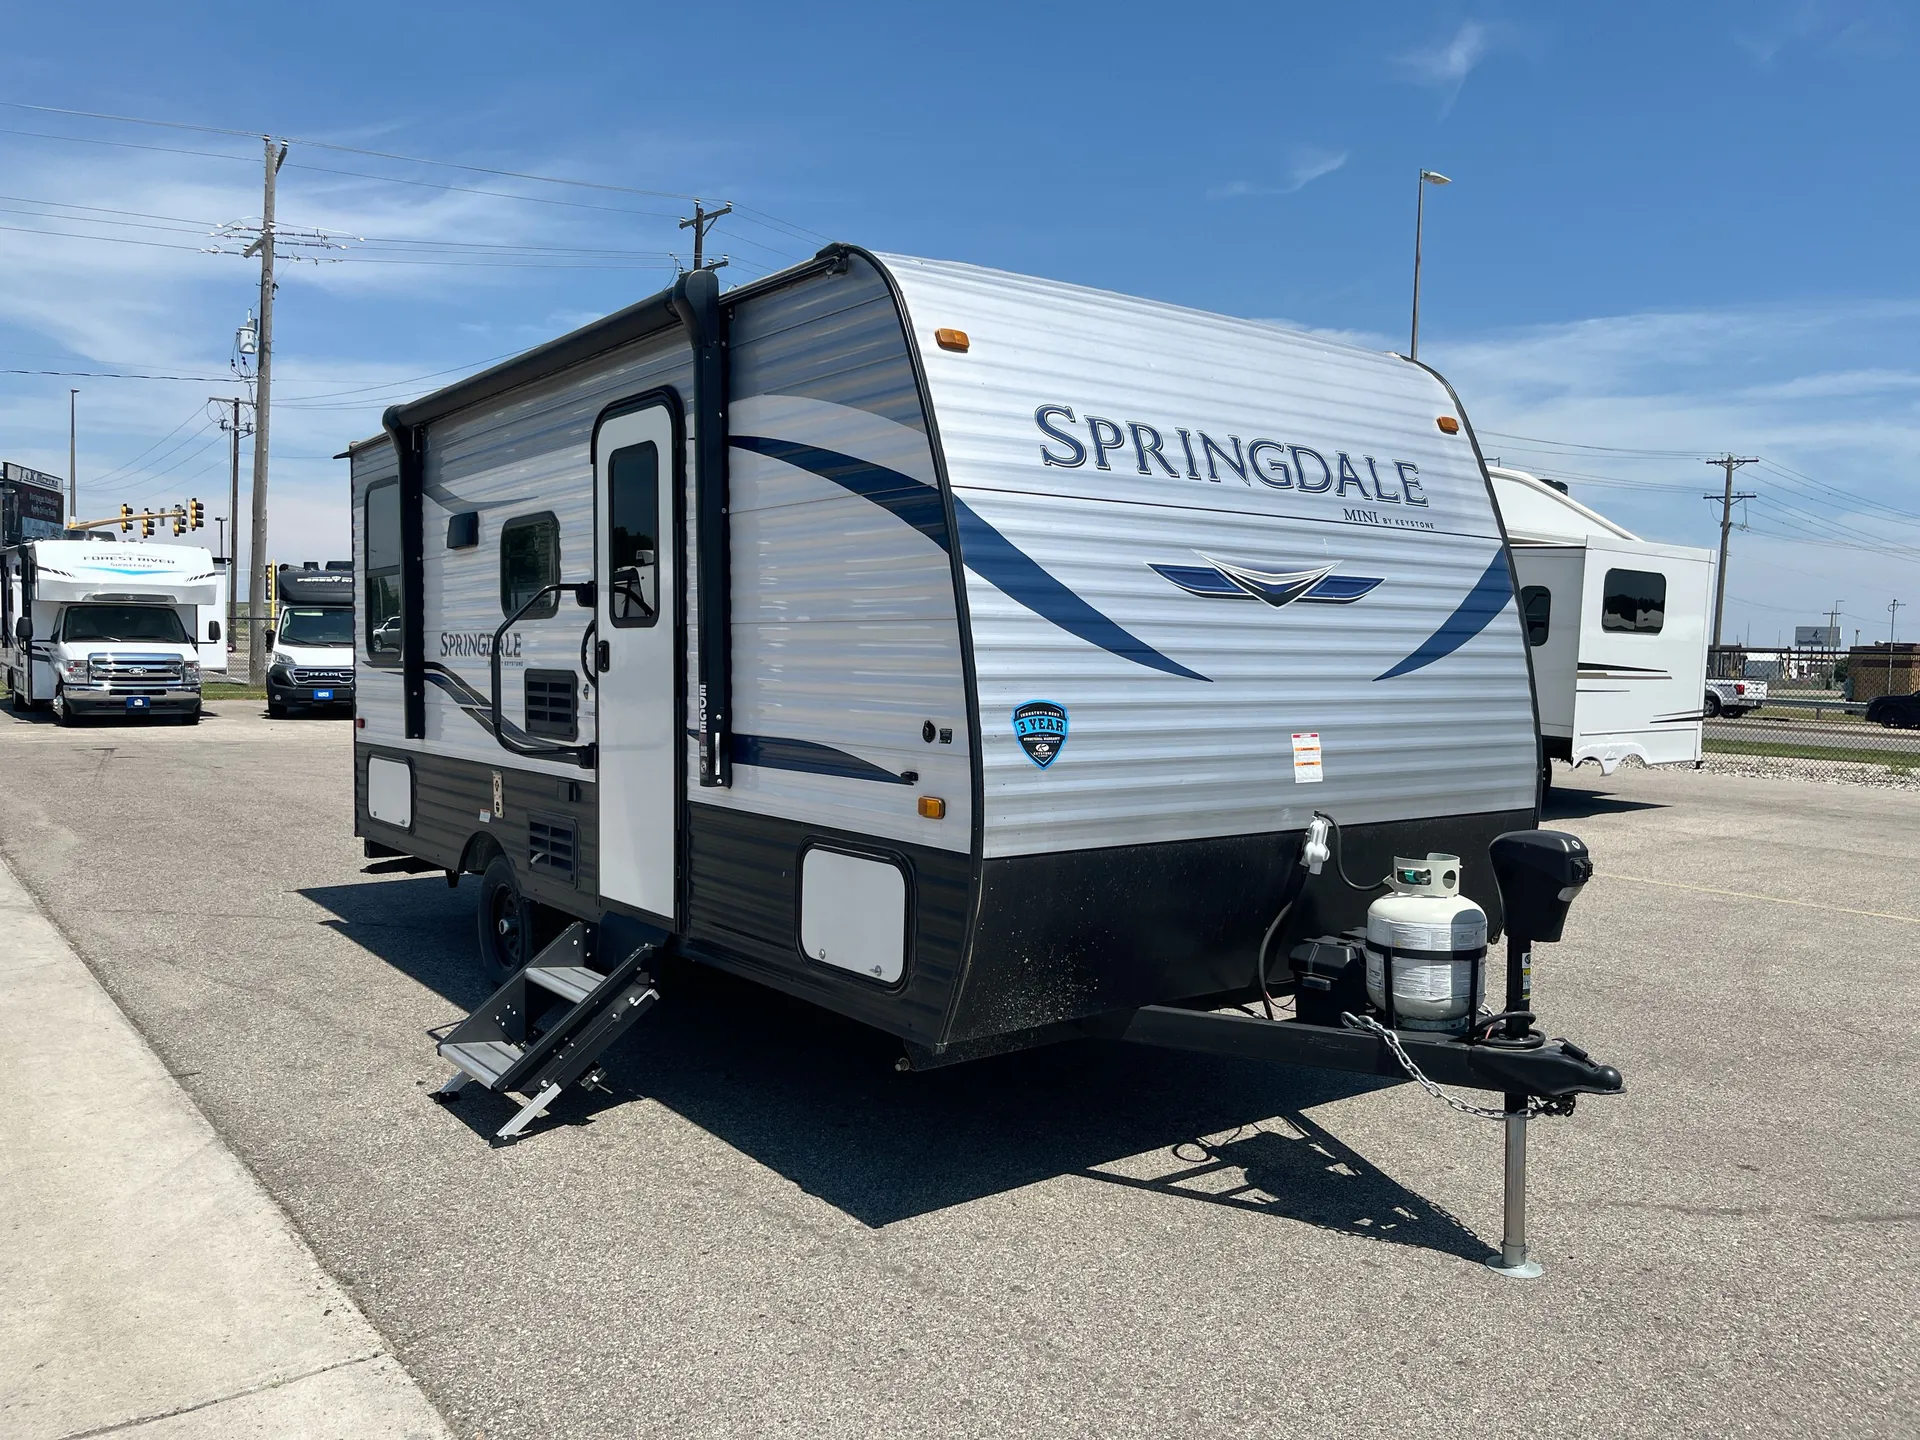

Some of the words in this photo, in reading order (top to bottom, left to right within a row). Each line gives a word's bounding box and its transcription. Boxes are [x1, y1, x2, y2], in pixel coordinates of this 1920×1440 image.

[1033, 403, 1429, 507] SPRINGDALE
[1343, 508, 1379, 524] MINI
[1382, 517, 1392, 525] BY
[1395, 519, 1435, 529] KEYSTONE
[699, 684, 708, 734] EDGE
[1018, 720, 1027, 733] 3
[1028, 717, 1064, 733] YEAR
